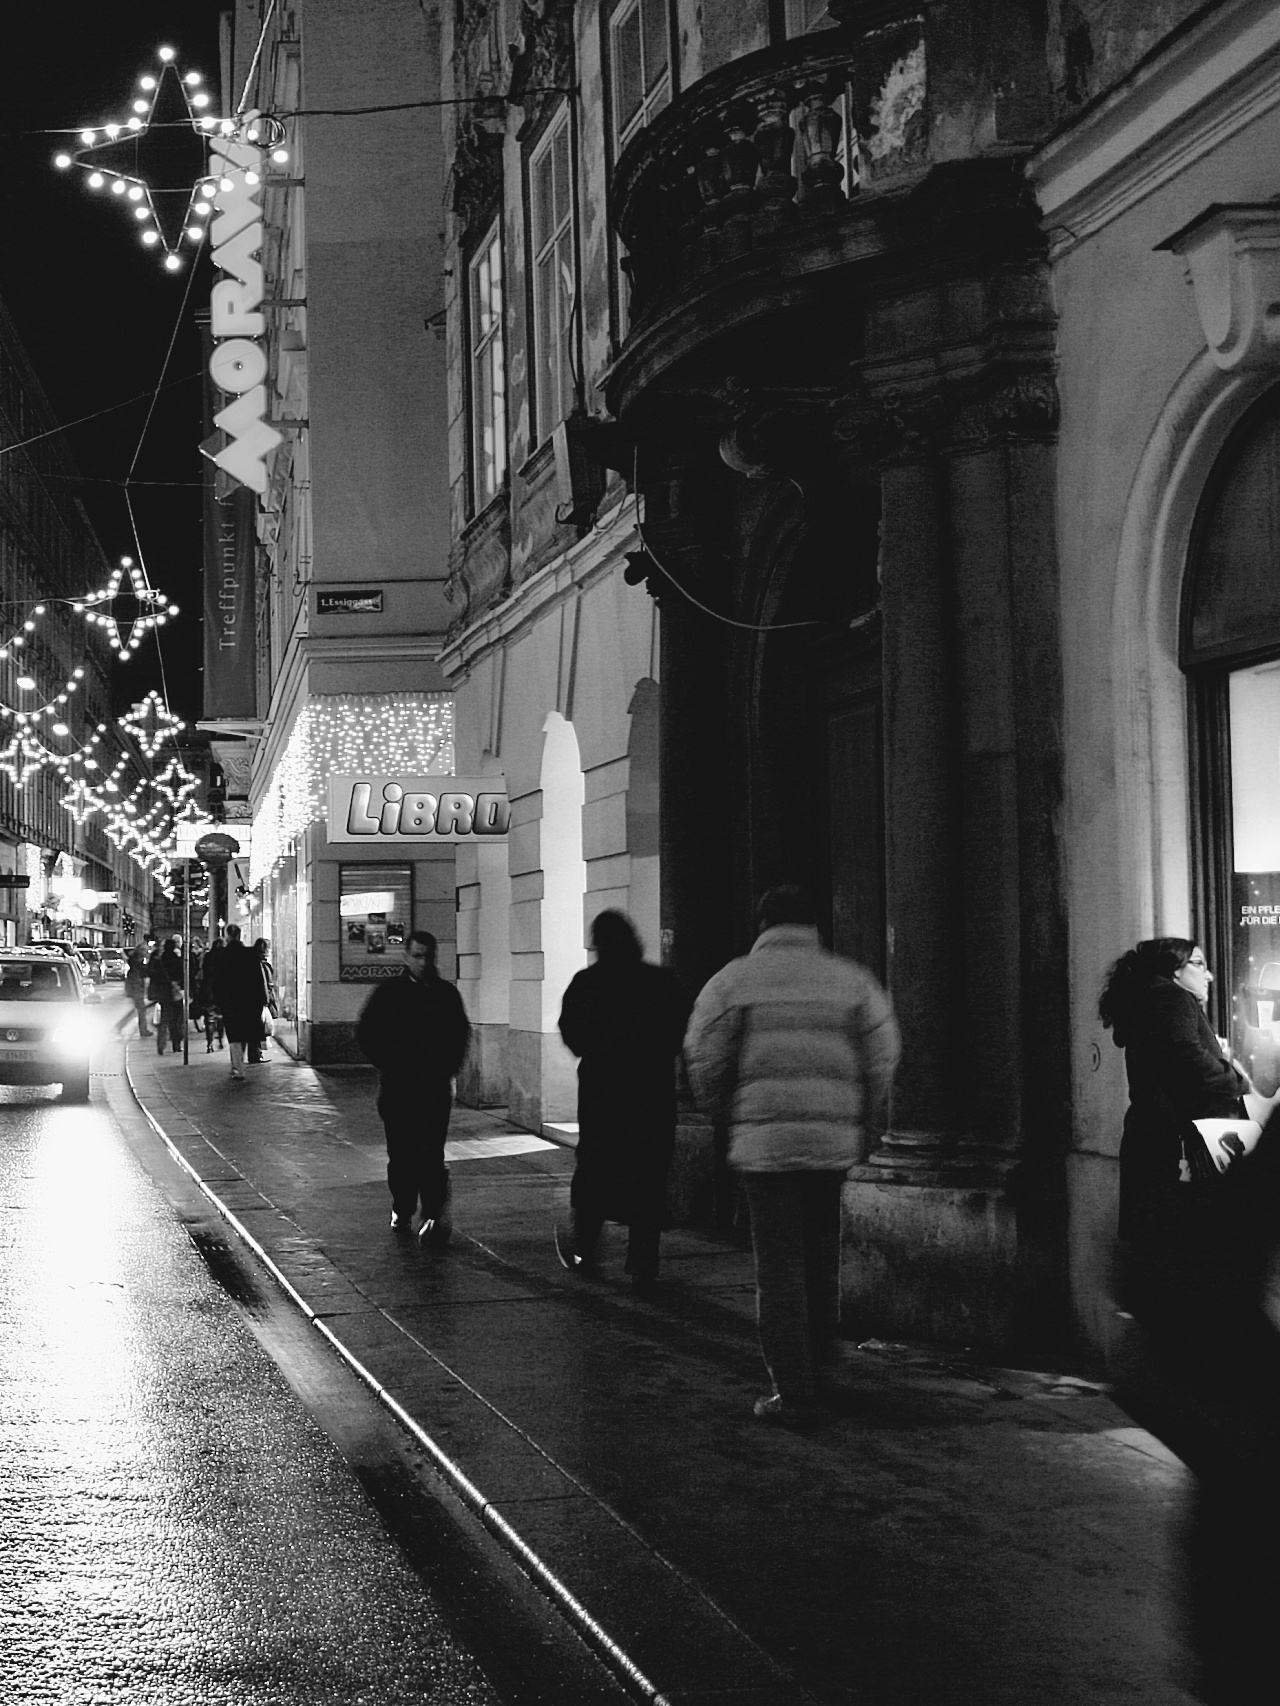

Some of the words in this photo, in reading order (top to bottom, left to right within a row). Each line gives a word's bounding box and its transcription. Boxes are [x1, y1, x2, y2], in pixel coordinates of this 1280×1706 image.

[218, 523, 239, 650] Treffpunkt
[1241, 905, 1257, 914] EIN
[1262, 916, 1277, 924] DIE
[341, 966, 404, 980] MORAW
